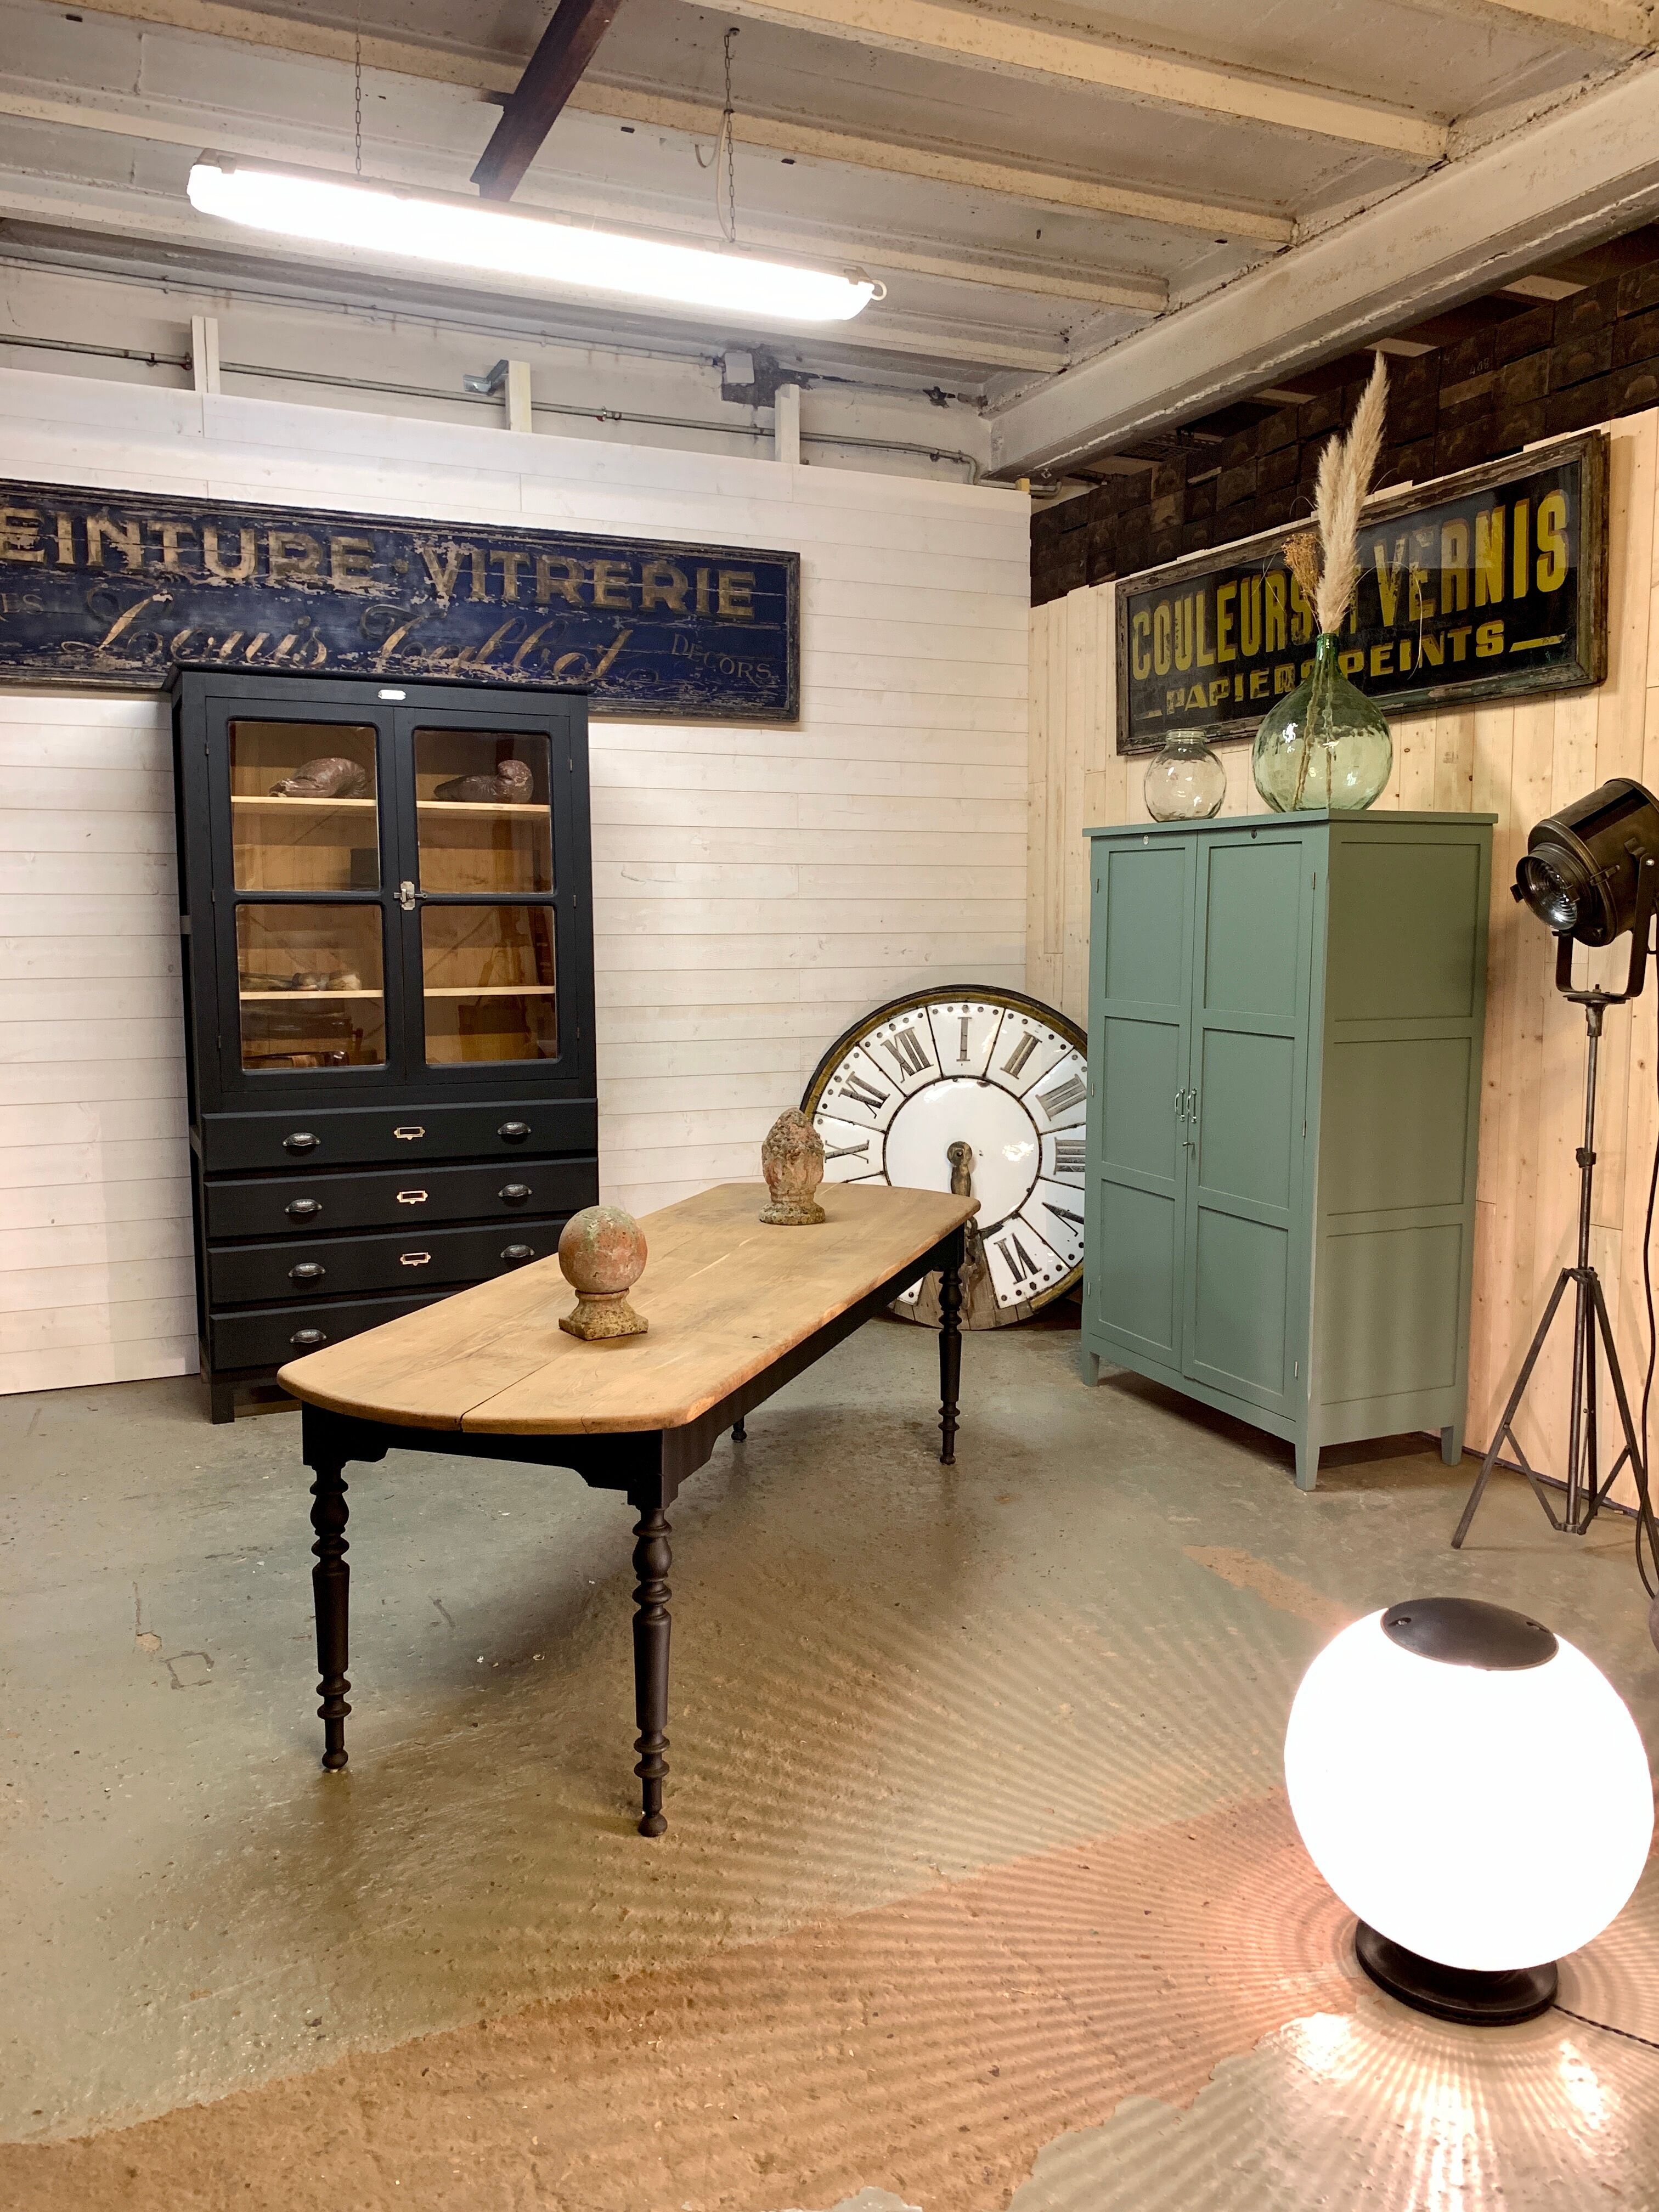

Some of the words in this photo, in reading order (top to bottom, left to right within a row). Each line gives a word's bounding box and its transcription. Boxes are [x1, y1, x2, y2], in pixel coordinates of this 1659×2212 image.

[420, 549, 756, 619] VITRERIE
[1132, 568, 1313, 680] COULEURS
[1374, 489, 1568, 627] VERNIS
[1338, 620, 1505, 680] PEINTS
[956, 1016, 972, 1062] I
[1000, 1031, 1042, 1079] II
